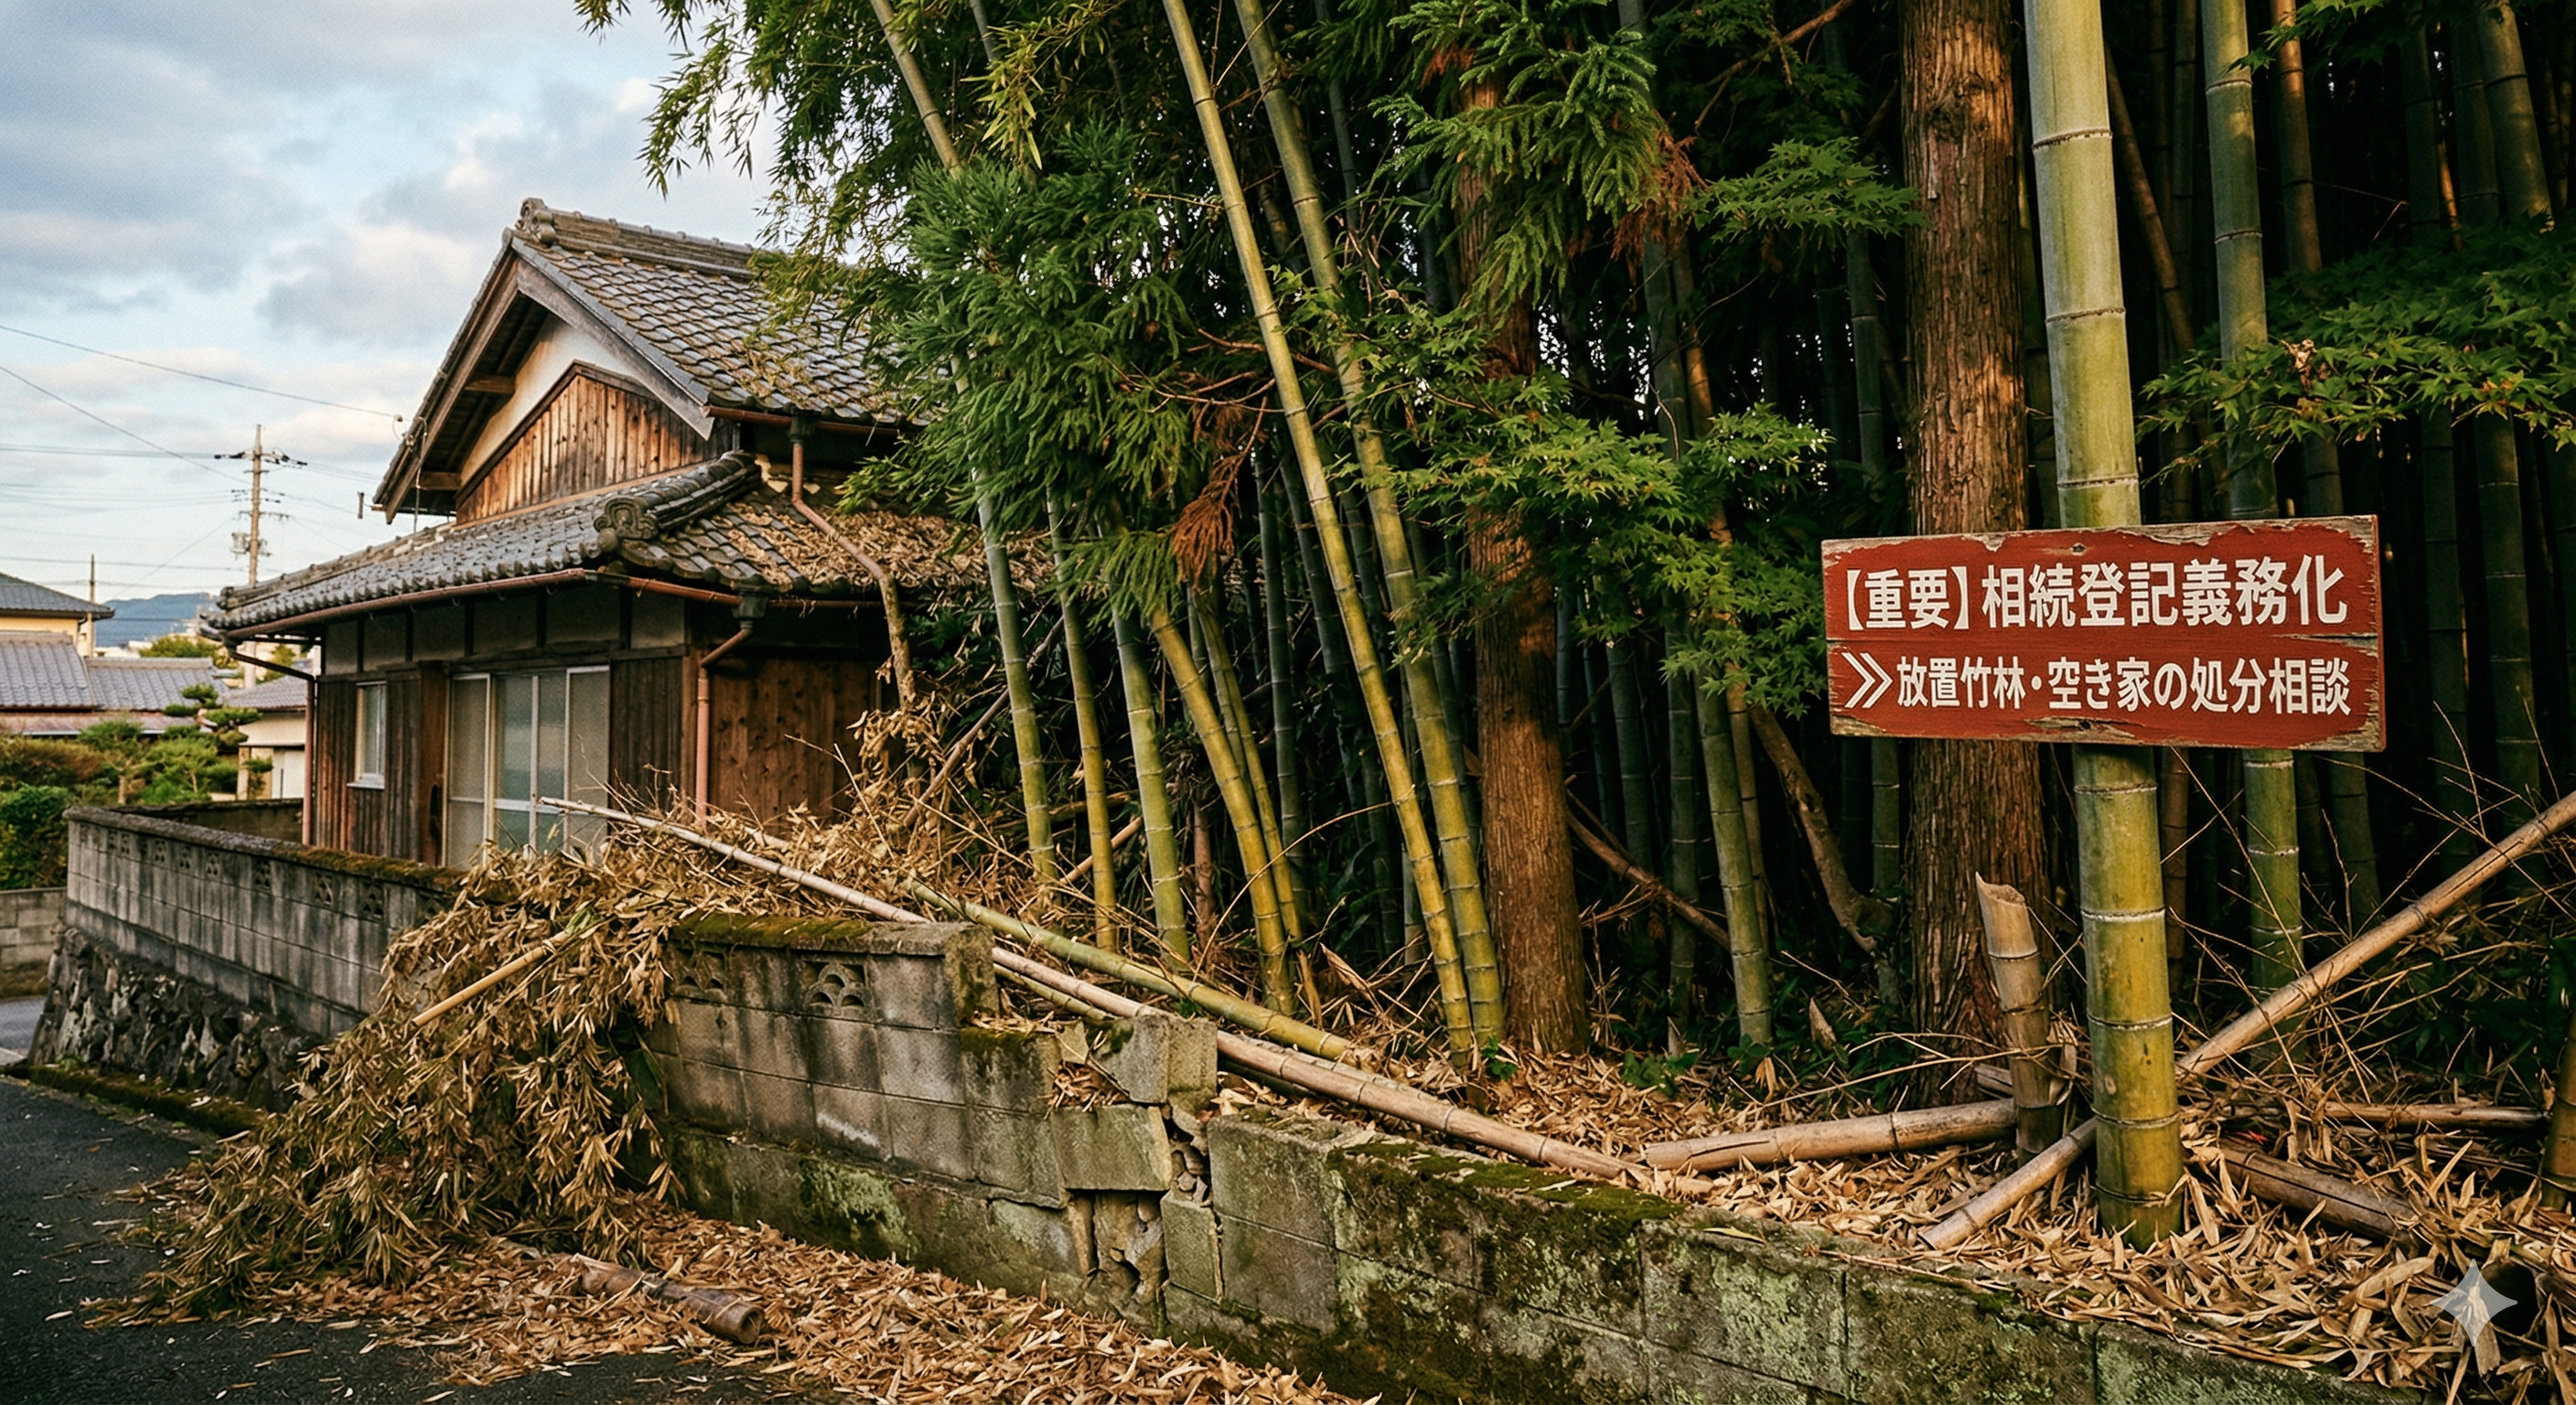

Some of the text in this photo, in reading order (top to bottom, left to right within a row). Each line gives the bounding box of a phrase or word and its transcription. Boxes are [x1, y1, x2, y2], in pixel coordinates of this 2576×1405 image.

[1846, 554, 2348, 631] 【重要】相続登記義務化
[1896, 655, 2351, 716] 放置竹林・空き家の処分相談
